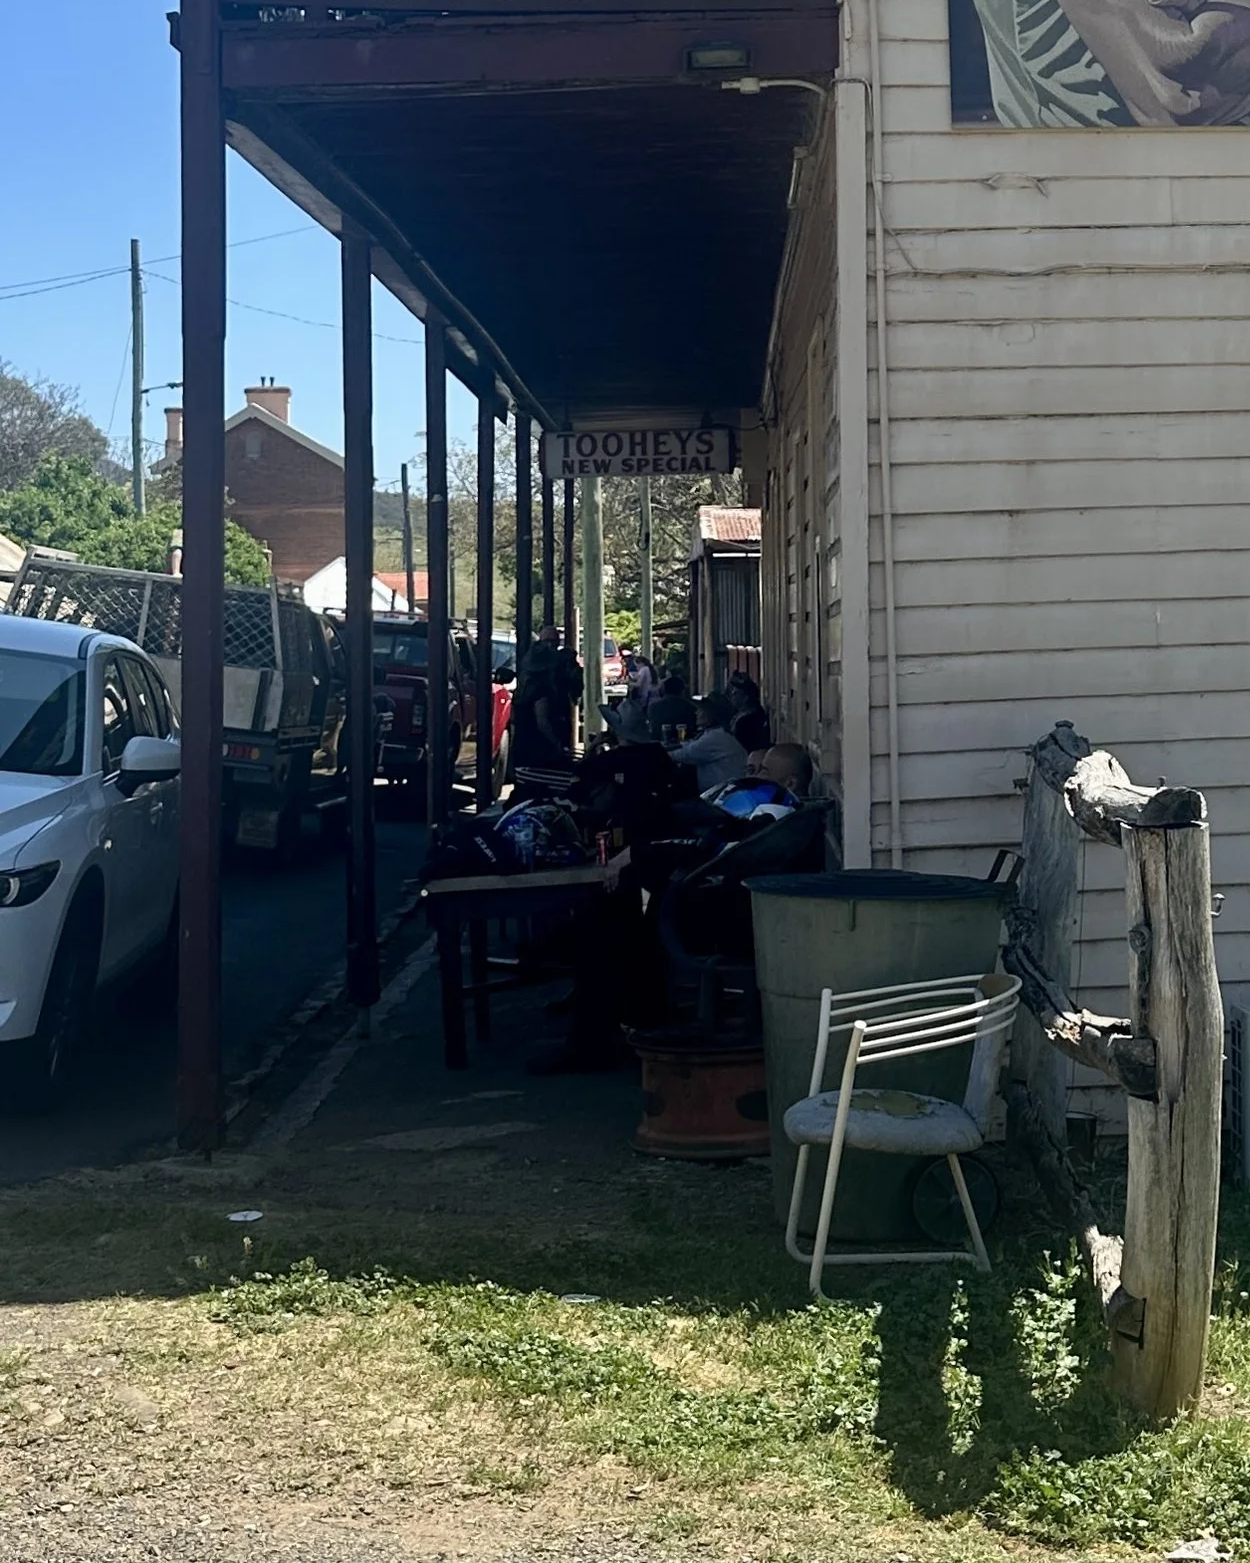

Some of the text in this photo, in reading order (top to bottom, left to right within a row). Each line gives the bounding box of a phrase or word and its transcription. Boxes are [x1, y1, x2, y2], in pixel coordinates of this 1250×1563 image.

[557, 431, 715, 458] TOOHEYS
[561, 455, 716, 474] NEW SPECIAL
